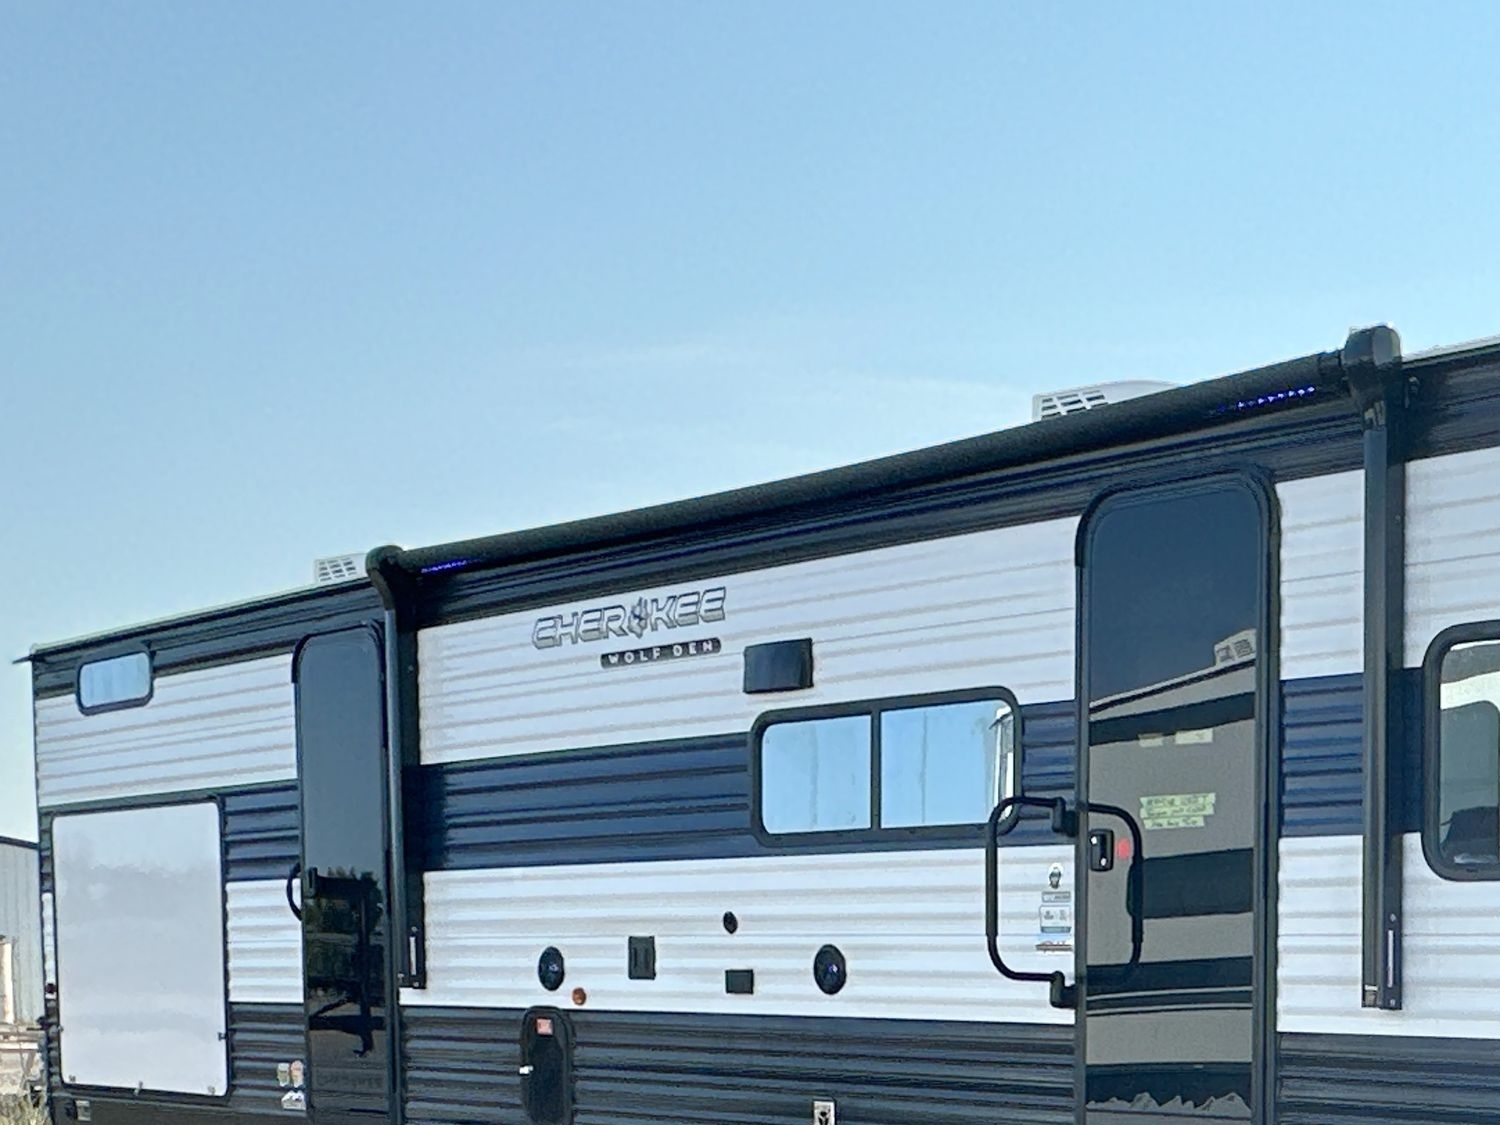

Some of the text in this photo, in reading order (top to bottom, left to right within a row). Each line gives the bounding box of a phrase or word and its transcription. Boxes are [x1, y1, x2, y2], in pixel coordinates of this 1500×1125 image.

[532, 586, 727, 650] CHEROKEE
[607, 640, 714, 665] WOLF DEN
